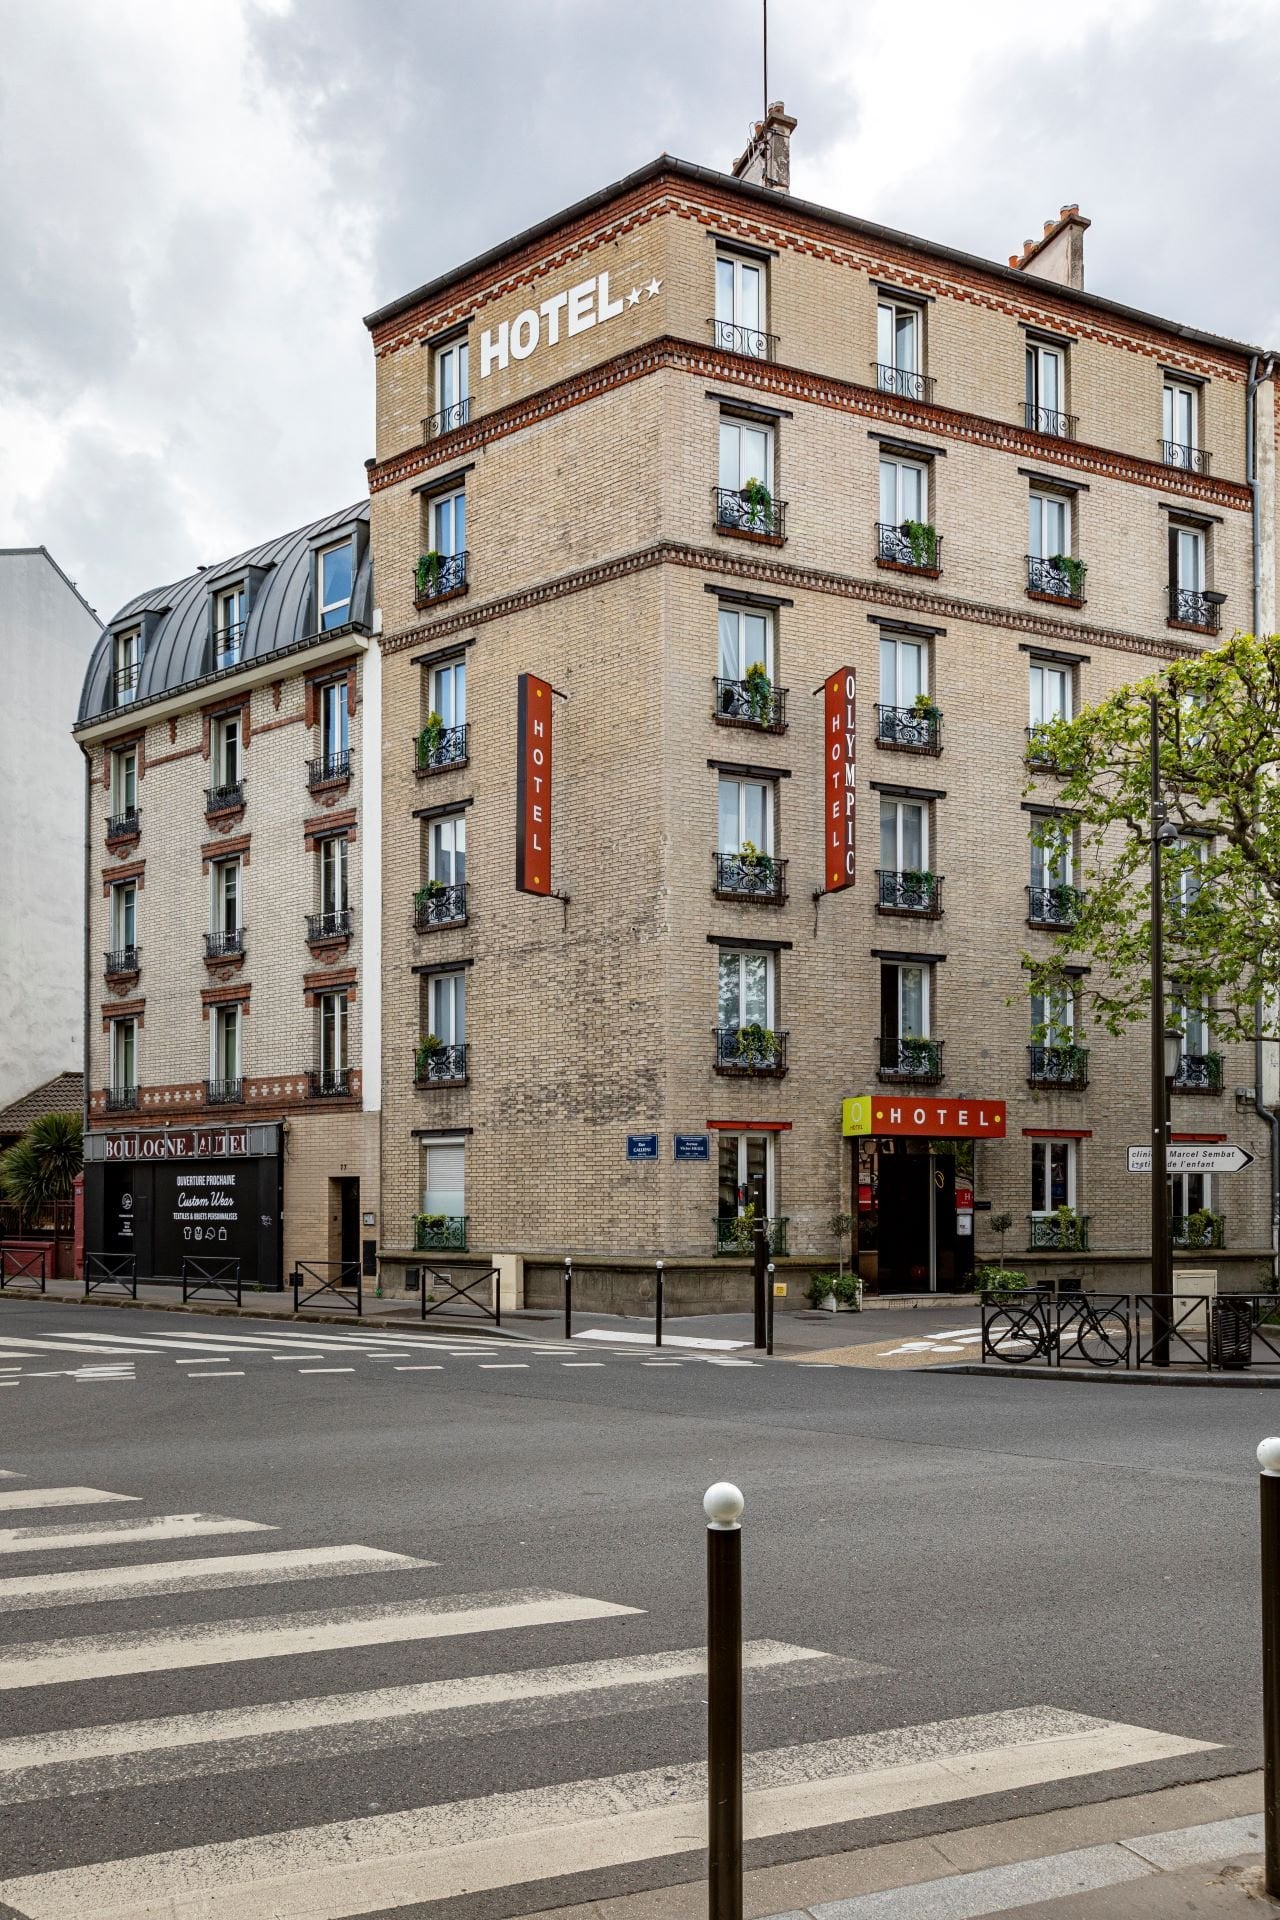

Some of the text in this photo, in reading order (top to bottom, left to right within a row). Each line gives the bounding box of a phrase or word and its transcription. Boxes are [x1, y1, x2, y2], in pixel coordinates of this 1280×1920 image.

[480, 271, 624, 379] HOTEL
[832, 713, 840, 848] HOTEL
[844, 675, 856, 875] OLYMPIC
[532, 719, 544, 851] HOTEL
[890, 1107, 989, 1126] HOTEL
[106, 1138, 186, 1157] BOULOGNE
[1169, 1150, 1202, 1158] Marcel
[1202, 1150, 1235, 1158] Sembat
[1167, 1160, 1177, 1168] de
[1180, 1160, 1214, 1168] l'enfant
[176, 1174, 236, 1186] OUVERTURE PROCHAINE
[178, 1191, 234, 1207] Custom Wear
